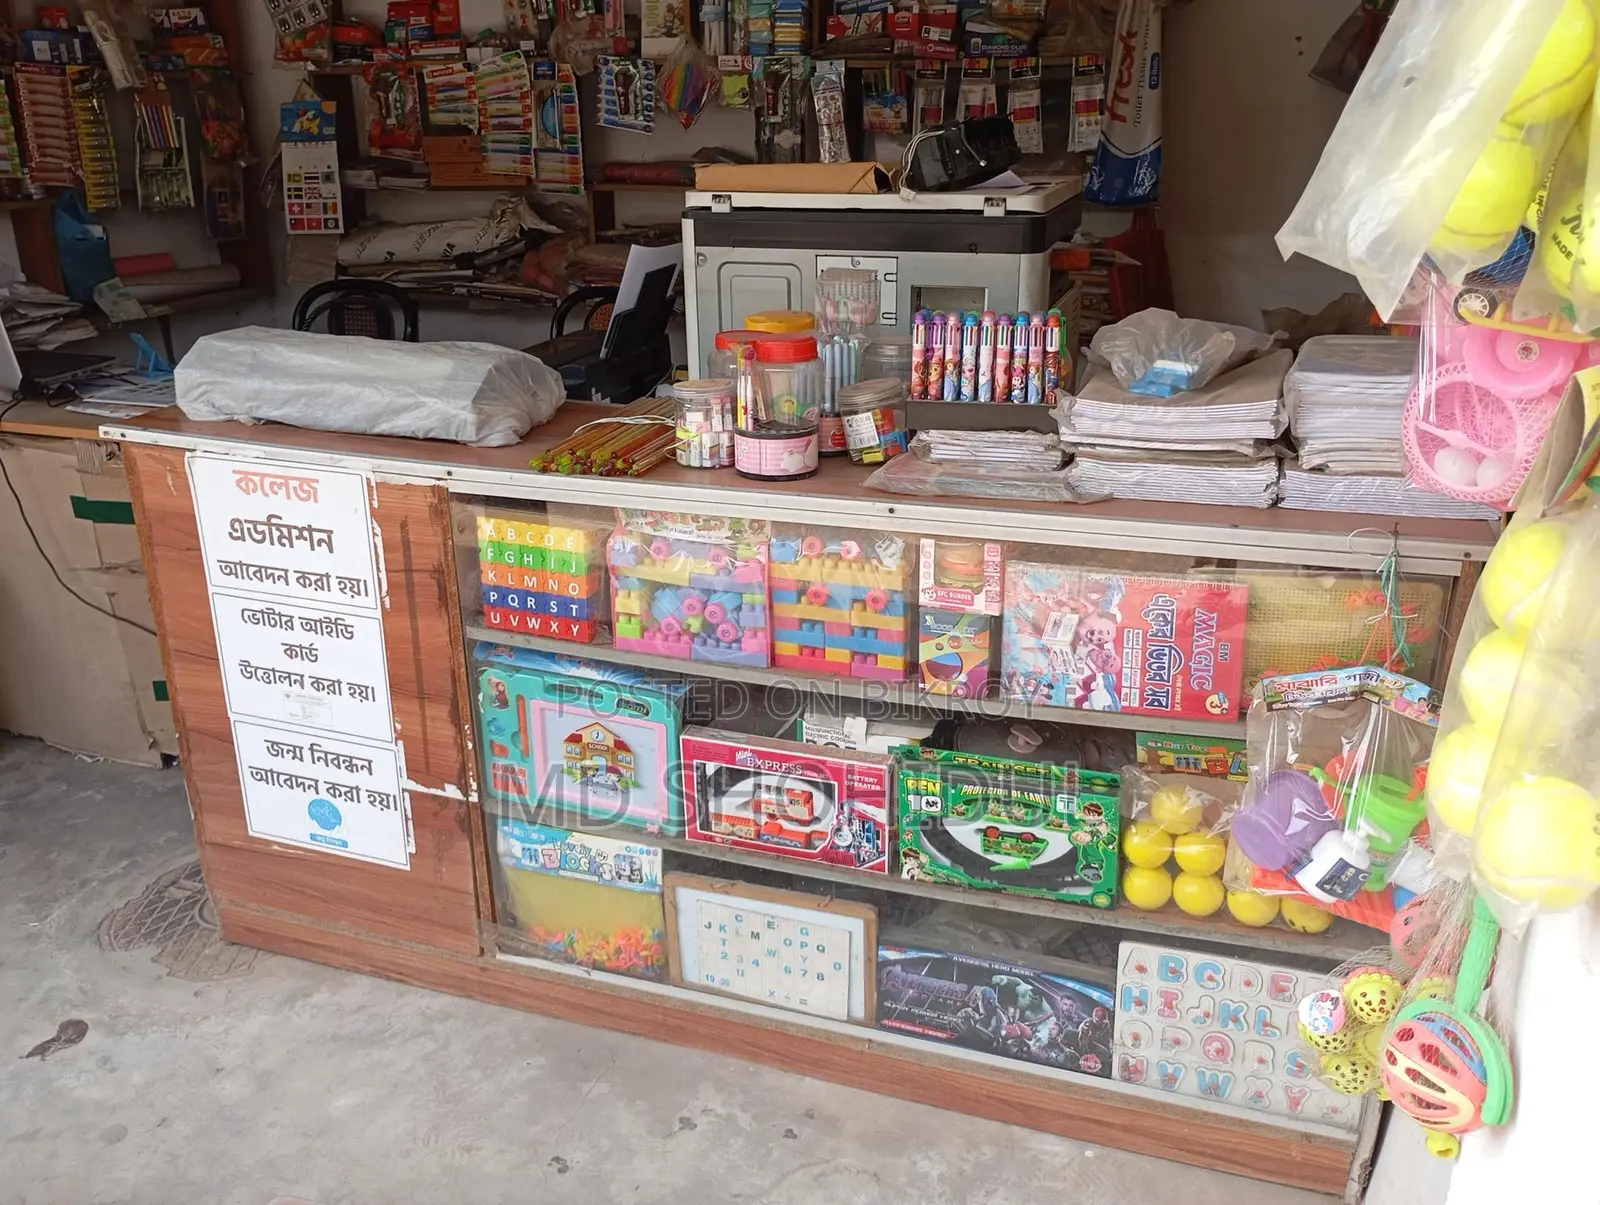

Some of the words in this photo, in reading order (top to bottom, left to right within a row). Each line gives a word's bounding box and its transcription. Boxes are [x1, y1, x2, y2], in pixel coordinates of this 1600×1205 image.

[1150, 76, 1158, 84] 12
[1133, 96, 1142, 128] Toilet
[1551, 232, 1574, 260] MADE
[232, 469, 320, 504] কলেজ
[228, 514, 334, 554] এডমিশন
[507, 528, 516, 540] B
[526, 532, 535, 544] C
[545, 534, 554, 546] D
[567, 537, 574, 549] E
[488, 548, 494, 560] F
[504, 551, 514, 563] G
[524, 554, 534, 566] H
[570, 561, 576, 574] J
[216, 559, 290, 586] আবেদন
[294, 570, 332, 592] করা
[336, 576, 369, 598] হয়।
[488, 570, 496, 582] K
[508, 572, 515, 584] L
[524, 576, 537, 588] M
[548, 578, 558, 591] N
[568, 583, 579, 595] O
[490, 592, 498, 602] P
[508, 594, 520, 608] Q
[527, 596, 536, 609] R
[550, 600, 558, 612] S
[570, 604, 578, 616] T
[240, 607, 295, 632] ভোটার
[298, 615, 355, 640] আইডি
[490, 612, 500, 624] U
[509, 614, 519, 626] V
[526, 616, 540, 630] W
[550, 620, 559, 634] X
[570, 624, 580, 636] Y
[1141, 594, 1178, 642] একের
[281, 642, 319, 664] কার্ড
[1189, 608, 1217, 690] MAGIC
[1219, 642, 1230, 662] BM
[1145, 642, 1184, 684] ভিতর
[238, 660, 305, 690] উত্তোলন
[308, 676, 342, 696] করা
[346, 682, 376, 703] হয়।
[1275, 674, 1338, 692] মাঝারি
[1144, 686, 1172, 710] সব
[588, 742, 609, 751] SCHOOL
[806, 731, 829, 740] ELECTRIC
[264, 739, 304, 762] জন্ম
[308, 743, 373, 776] নিবন্ধন
[736, 749, 753, 764] Mini
[746, 758, 803, 775] EXPRESS
[954, 756, 1011, 772] TRAIN
[1018, 764, 1052, 778] SET
[248, 766, 320, 796] আবেদন
[324, 781, 361, 804] করা
[366, 789, 398, 812] হয়।
[844, 780, 880, 790] OPERATED
[848, 774, 878, 782] BATTERY
[906, 778, 941, 796] BEN
[961, 784, 1009, 798] PROTECTOR
[1012, 790, 1023, 798] OF
[1024, 792, 1052, 808] EARTH
[552, 838, 592, 857] Lovely
[734, 914, 744, 922] C
[766, 920, 776, 930] E
[800, 928, 809, 936] G
[719, 924, 727, 933] K
[750, 931, 760, 940] M
[800, 941, 808, 950] P
[816, 944, 826, 954] Q
[720, 938, 728, 946] T
[766, 949, 777, 958] W
[800, 956, 808, 964] Y
[705, 974, 715, 983] 19
[720, 952, 728, 960] 2
[736, 955, 744, 964] 3
[752, 958, 760, 967] 4
[784, 965, 792, 974] 6
[800, 969, 808, 978] 7
[816, 972, 825, 981] 8
[736, 968, 745, 978] 12
[1012, 968, 1035, 976] MODEL
[1123, 948, 1149, 978] A
[1158, 952, 1188, 984] B
[1194, 960, 1226, 991] C
[1230, 965, 1263, 996] D
[1270, 972, 1298, 1004] E
[1121, 984, 1150, 1015] H
[1156, 988, 1183, 1021] I
[1187, 996, 1215, 1026] J
[1218, 999, 1249, 1032] K
[1254, 1005, 1282, 1039] L
[1162, 1026, 1192, 1054] P
[1200, 1032, 1235, 1064] Q
[1242, 1040, 1275, 1074] R
[1284, 1050, 1312, 1080] S
[1158, 1060, 1186, 1092] V
[1196, 1066, 1234, 1099] W
[1243, 1075, 1272, 1108] X
[1282, 1081, 1311, 1112] Y
